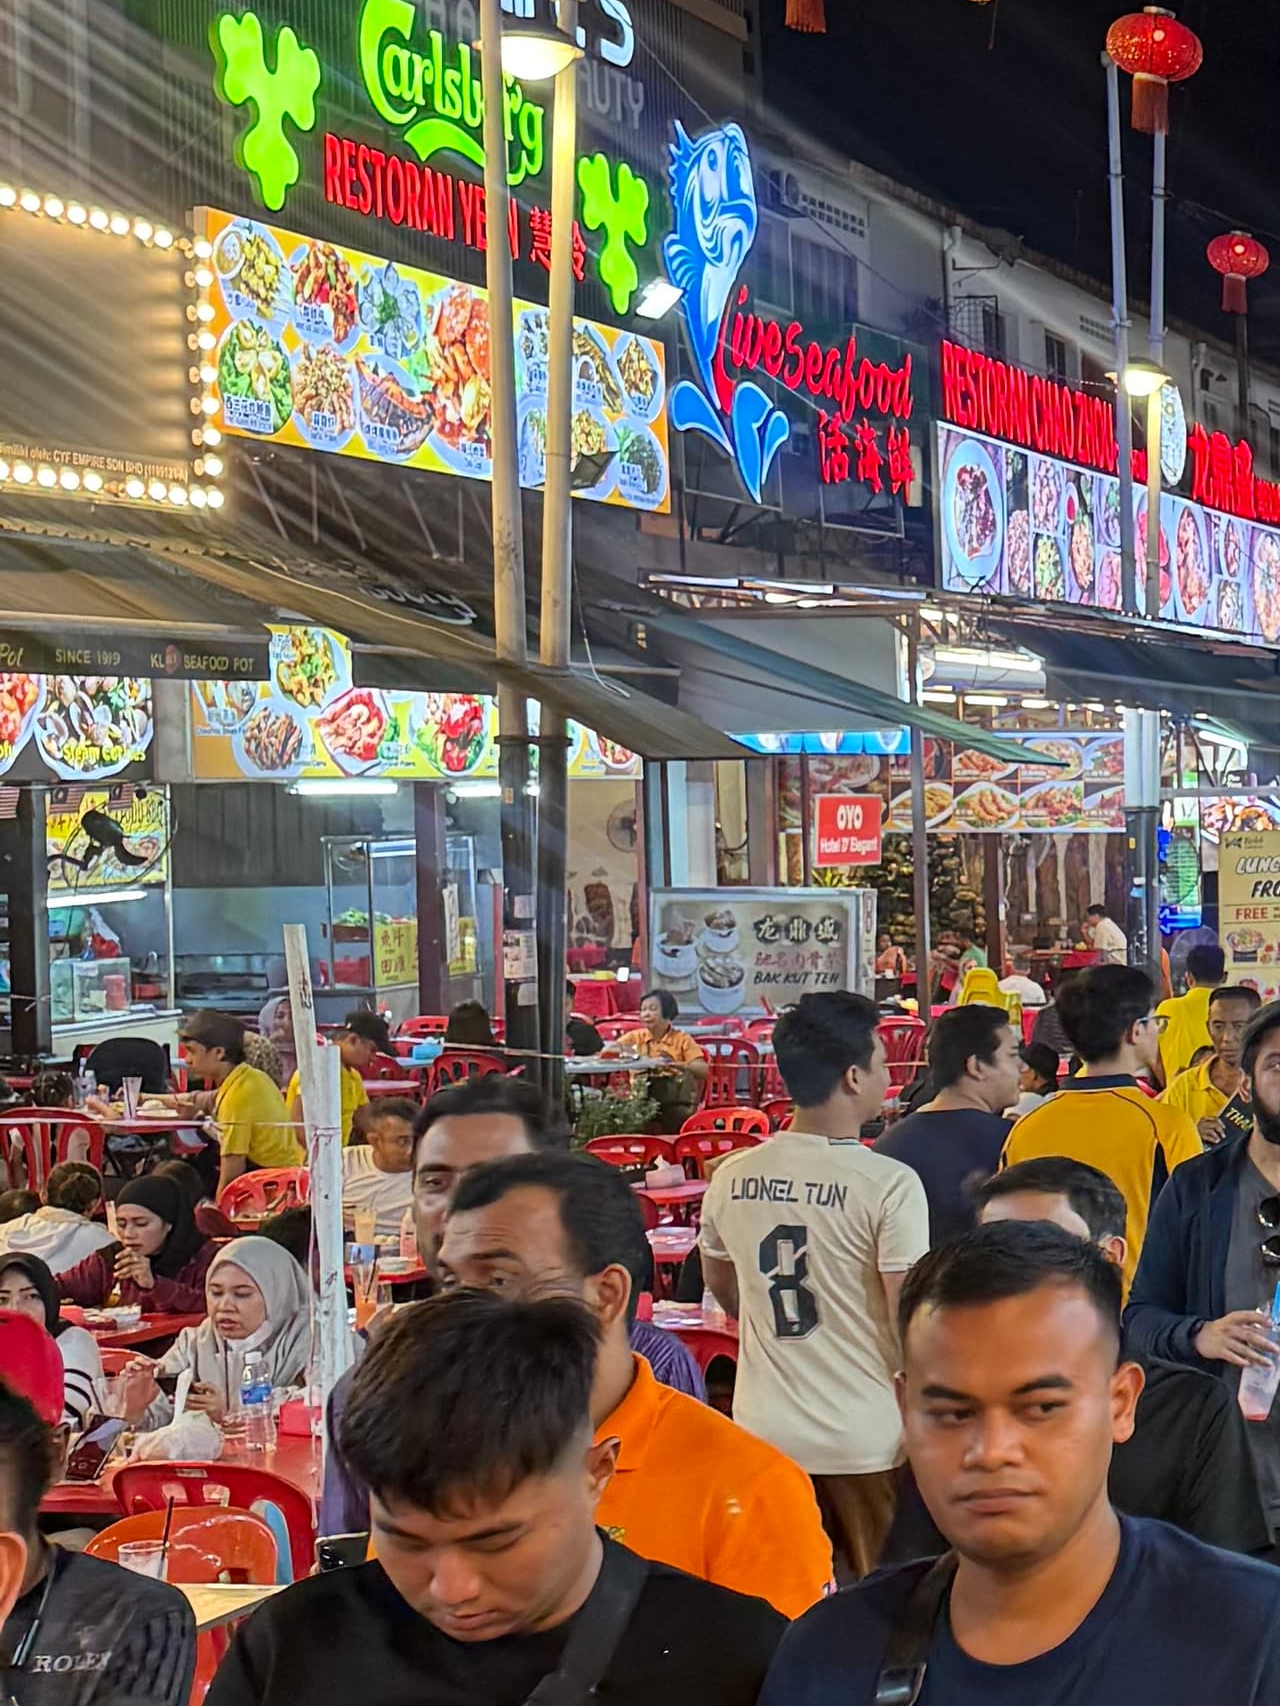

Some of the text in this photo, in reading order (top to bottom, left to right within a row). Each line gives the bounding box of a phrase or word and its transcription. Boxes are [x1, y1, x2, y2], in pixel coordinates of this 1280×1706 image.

[325, 133, 454, 240] RESTORAN
[941, 340, 1031, 445] RESTORAN
[1032, 373, 1074, 459] CHAO
[1074, 390, 1115, 472] ZHOU
[72, 452, 105, 470] EMPIRE
[106, 456, 125, 472] SDN
[125, 460, 144, 477] BHD
[55, 649, 91, 664] SINCE
[150, 652, 166, 669] KL
[183, 655, 229, 672] SEAFOOD
[233, 657, 254, 671] POT
[63, 741, 100, 764] Steam
[836, 804, 864, 830] OYO
[820, 837, 841, 853] Hotel
[1235, 907, 1268, 920] FREE
[753, 971, 840, 985] BAK KUT TEH
[731, 1174, 848, 1212] LIONEL TUN
[758, 1223, 819, 1338] 8
[31, 1650, 112, 1673] ROLEX
